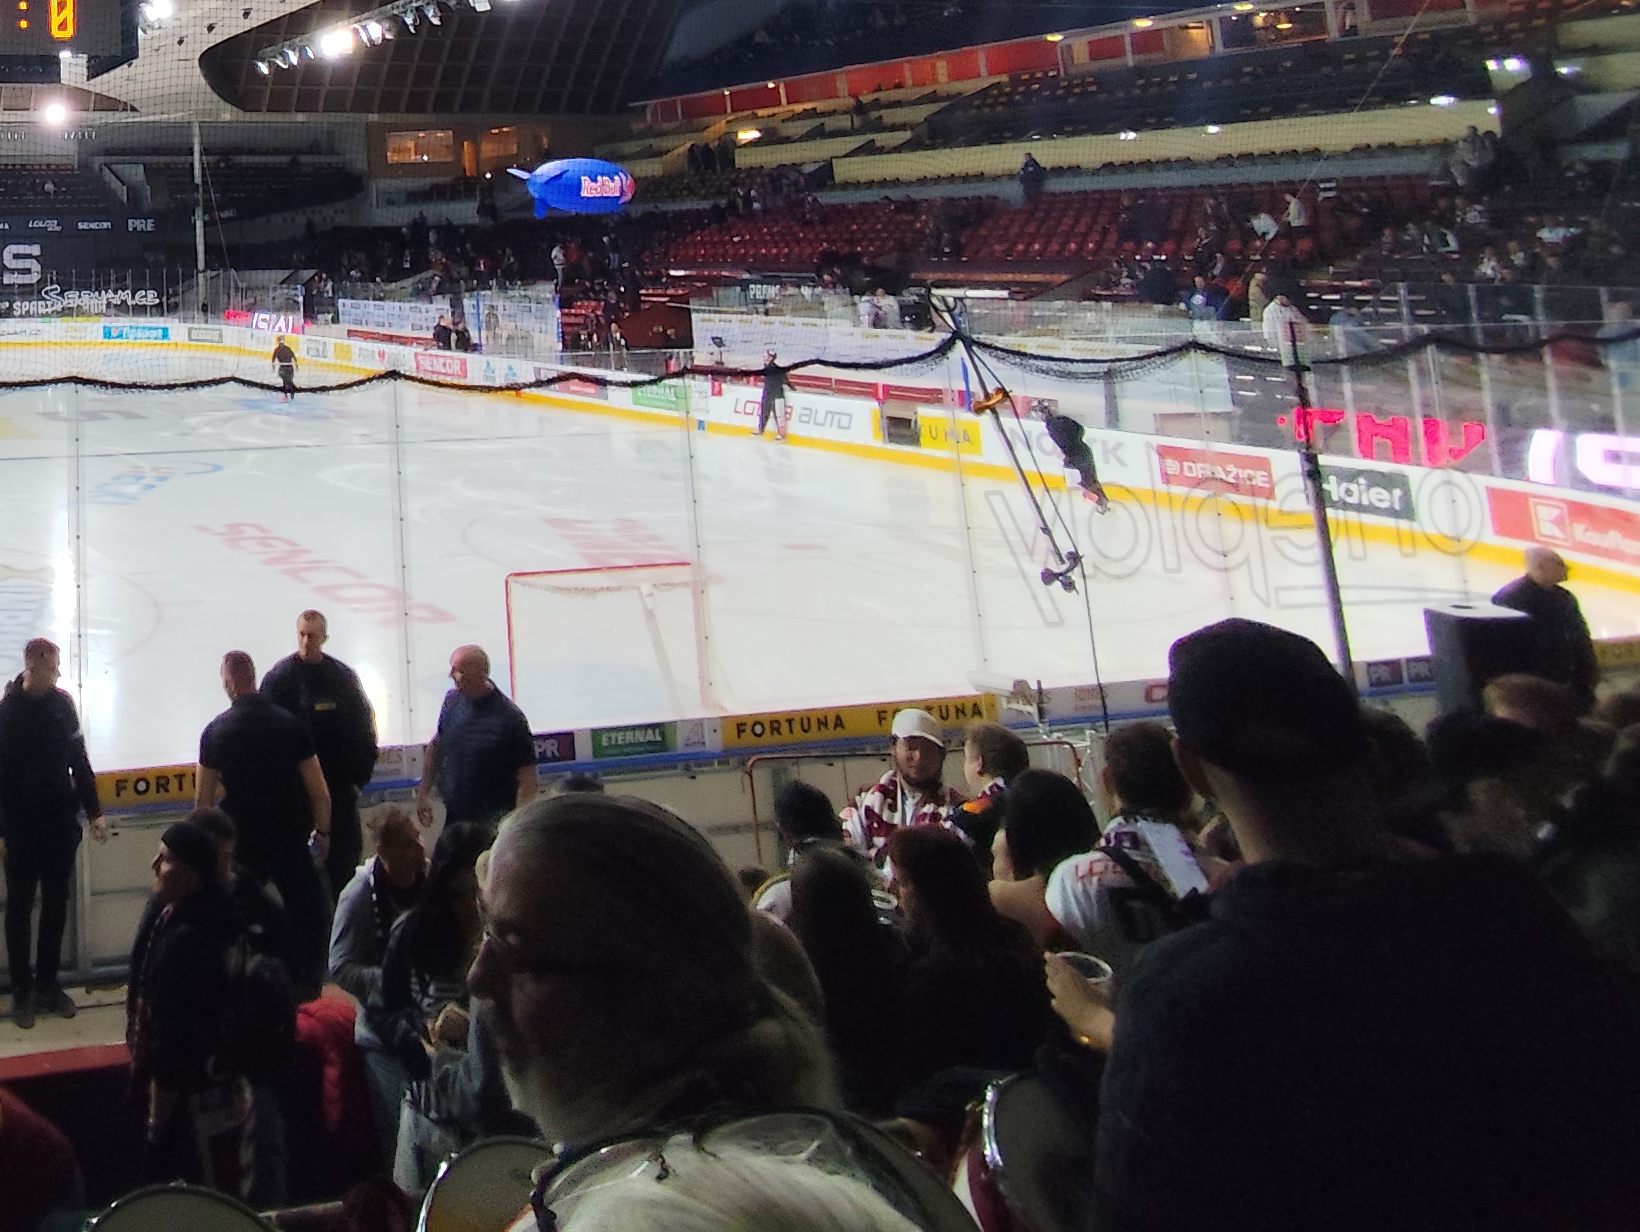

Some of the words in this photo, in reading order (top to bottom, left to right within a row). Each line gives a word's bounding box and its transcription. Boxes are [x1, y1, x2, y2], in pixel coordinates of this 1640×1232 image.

[581, 176, 601, 197] Red
[78, 221, 112, 230] SENCOR
[128, 218, 156, 232] PRE
[3, 244, 42, 285] S
[735, 714, 845, 739] FORTUNA
[601, 728, 663, 747] ETERNAL
[115, 773, 197, 799] FORT
